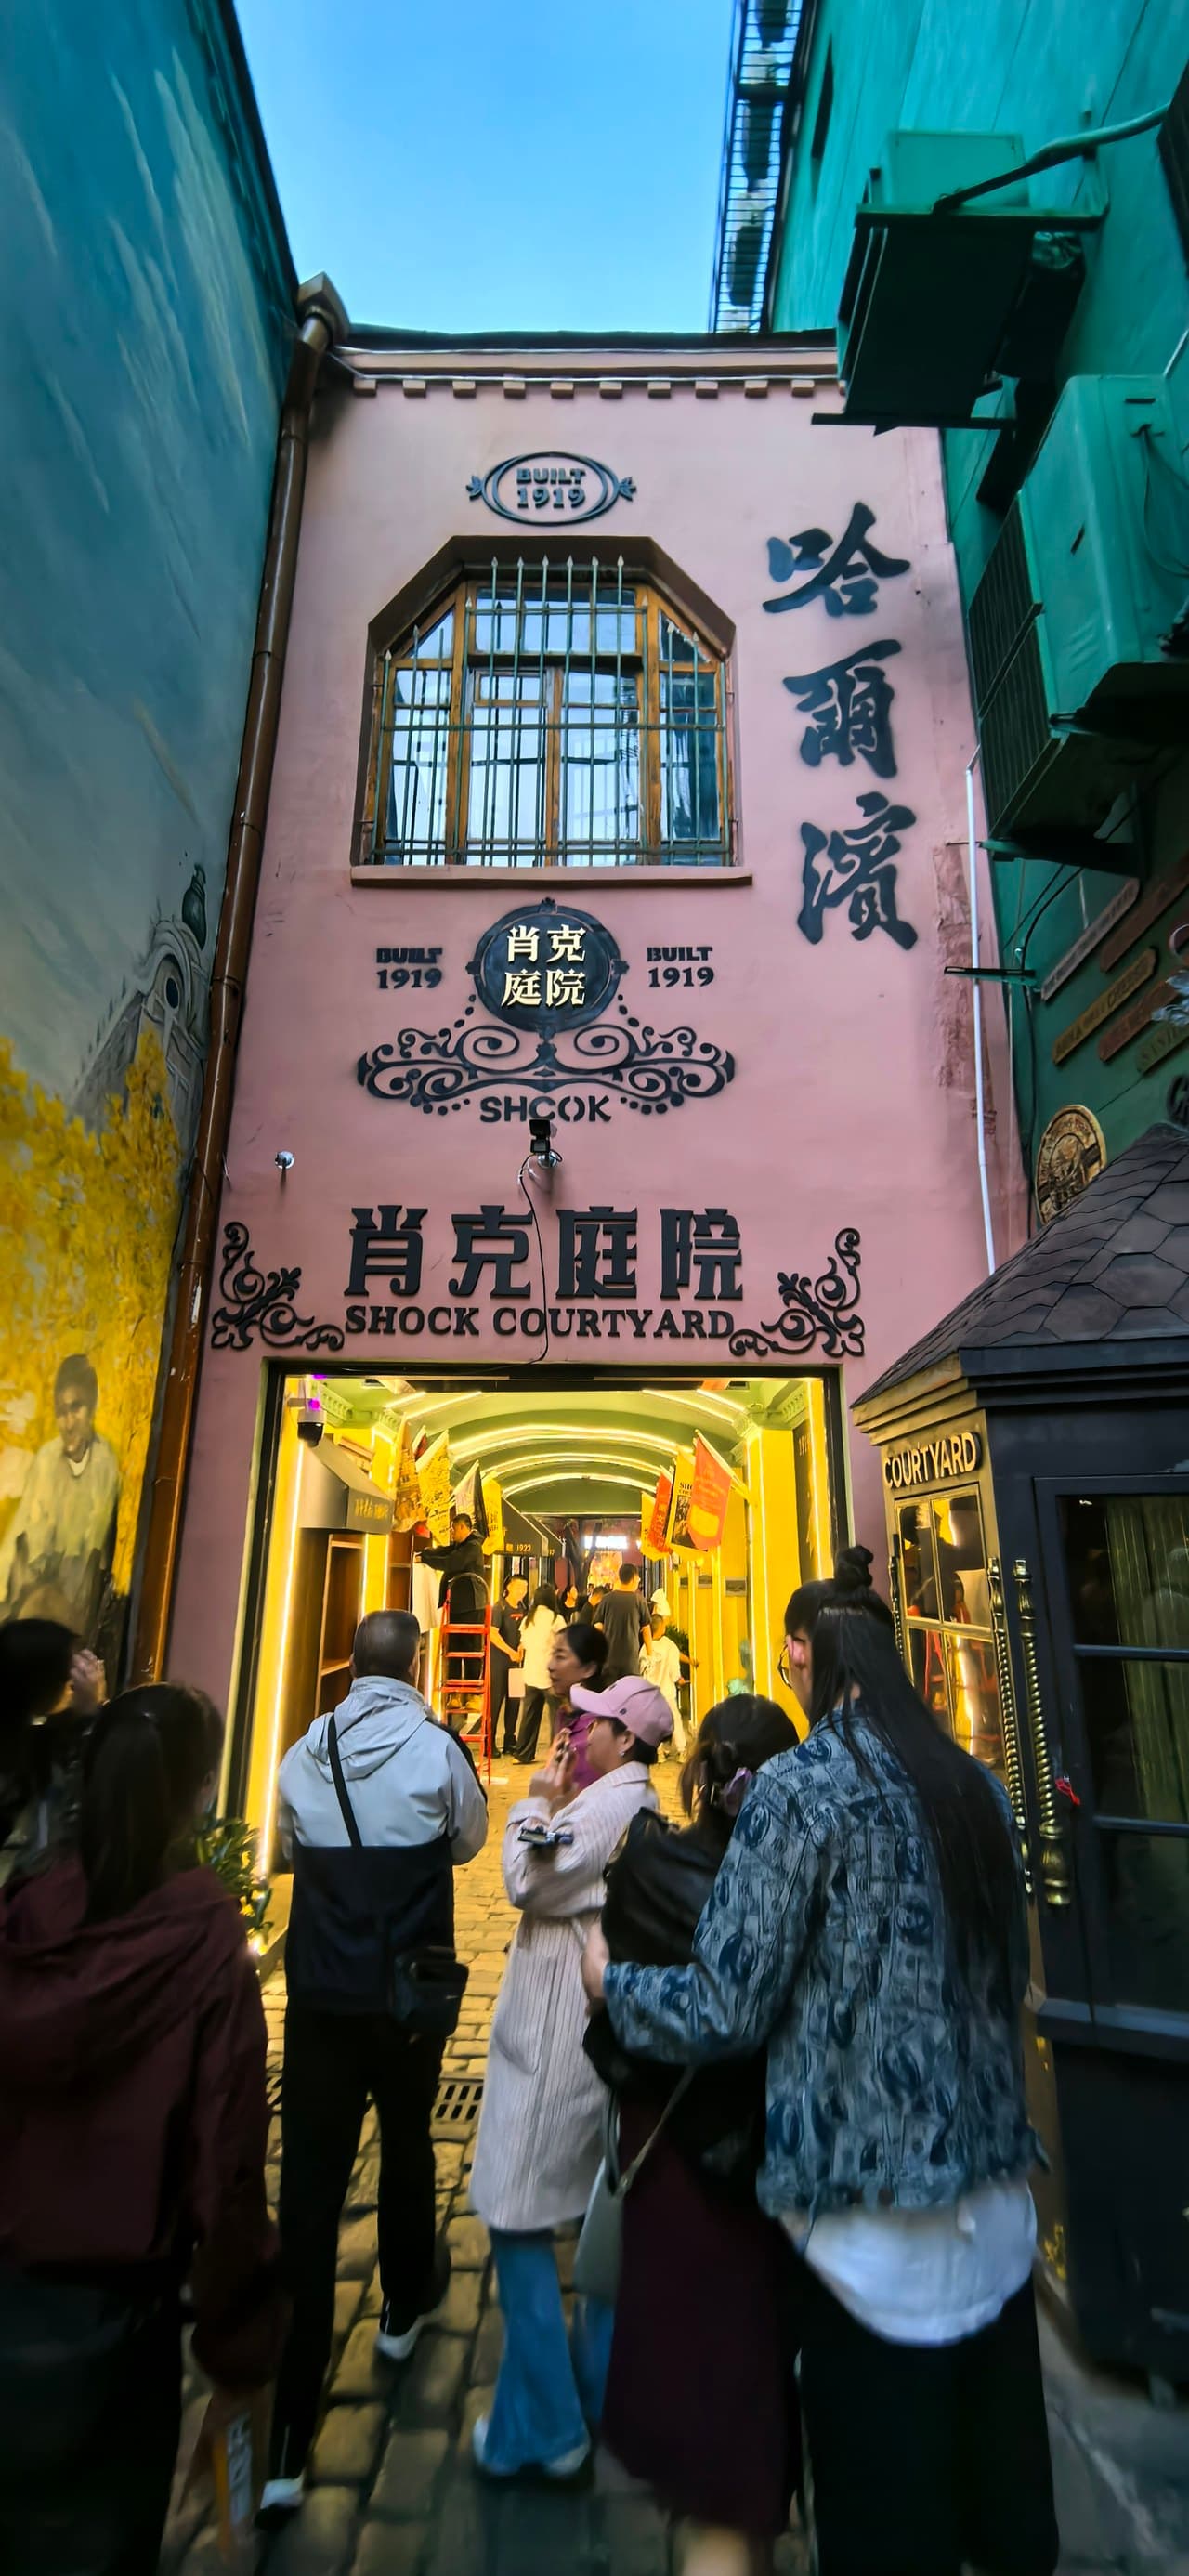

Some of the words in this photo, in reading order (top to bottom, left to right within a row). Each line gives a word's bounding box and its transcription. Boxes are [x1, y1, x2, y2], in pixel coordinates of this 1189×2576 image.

[516, 468, 586, 485] BUILT
[517, 486, 586, 509] 1919
[762, 502, 919, 951] 哈爾濱
[376, 947, 443, 964] BUILT
[505, 924, 587, 963] 肖克
[647, 946, 714, 962] BUILT
[377, 967, 443, 989] 1919
[501, 969, 587, 1009] 庭院
[648, 966, 715, 987] 1919
[343, 1205, 743, 1300] 肖克庭院
[345, 1305, 480, 1337] SHOCK
[492, 1307, 736, 1339] COURTYARD
[883, 1431, 983, 1488] COURTYARD
